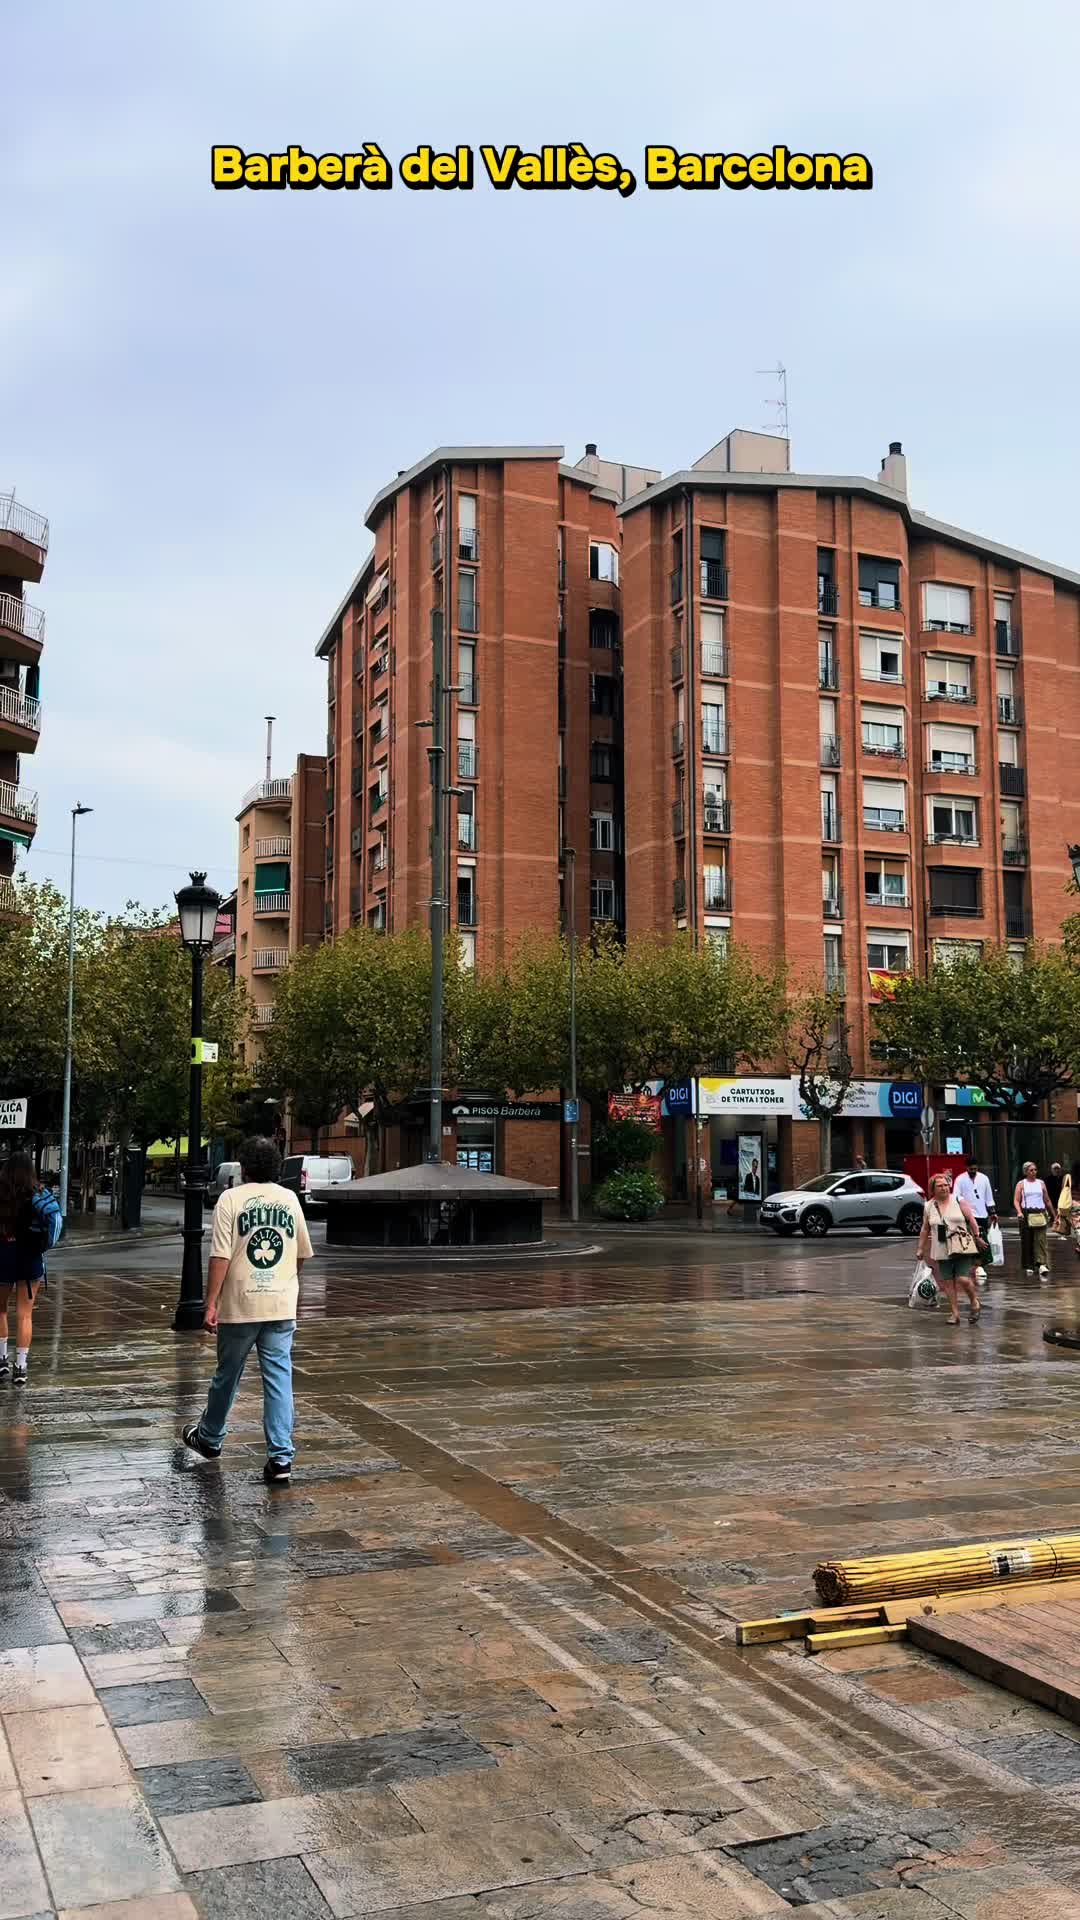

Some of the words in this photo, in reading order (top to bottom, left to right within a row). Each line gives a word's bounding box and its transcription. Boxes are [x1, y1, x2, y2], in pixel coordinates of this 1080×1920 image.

[669, 1087, 689, 1100] DIGI
[893, 1091, 918, 1104] DIGI
[0, 1102, 22, 1112] LICA
[472, 1107, 500, 1115] PISOS
[237, 1207, 295, 1239] CELTICS
[250, 1230, 282, 1247] CELTICS
